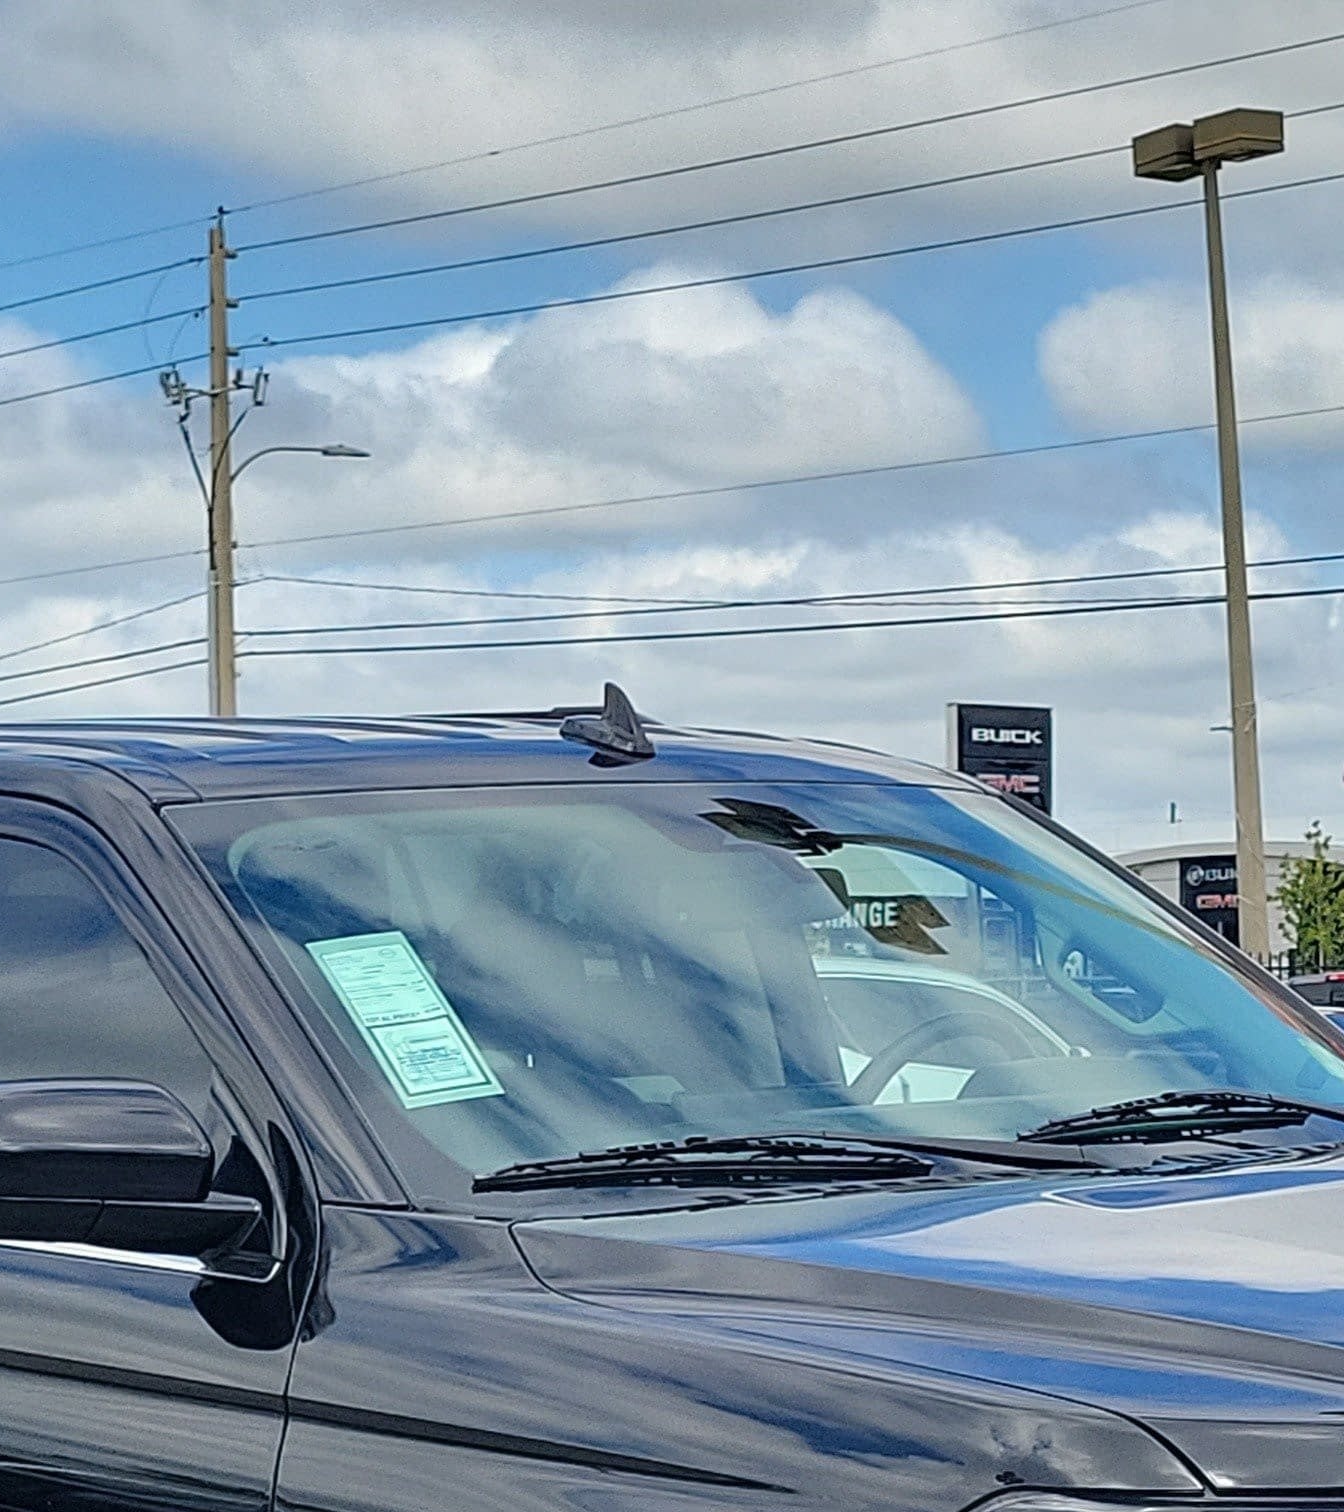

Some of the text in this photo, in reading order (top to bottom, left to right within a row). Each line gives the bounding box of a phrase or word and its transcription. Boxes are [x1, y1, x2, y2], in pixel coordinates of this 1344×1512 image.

[971, 728, 1043, 744] BUICK
[1204, 868, 1236, 882] BUI
[1196, 894, 1238, 909] GM
